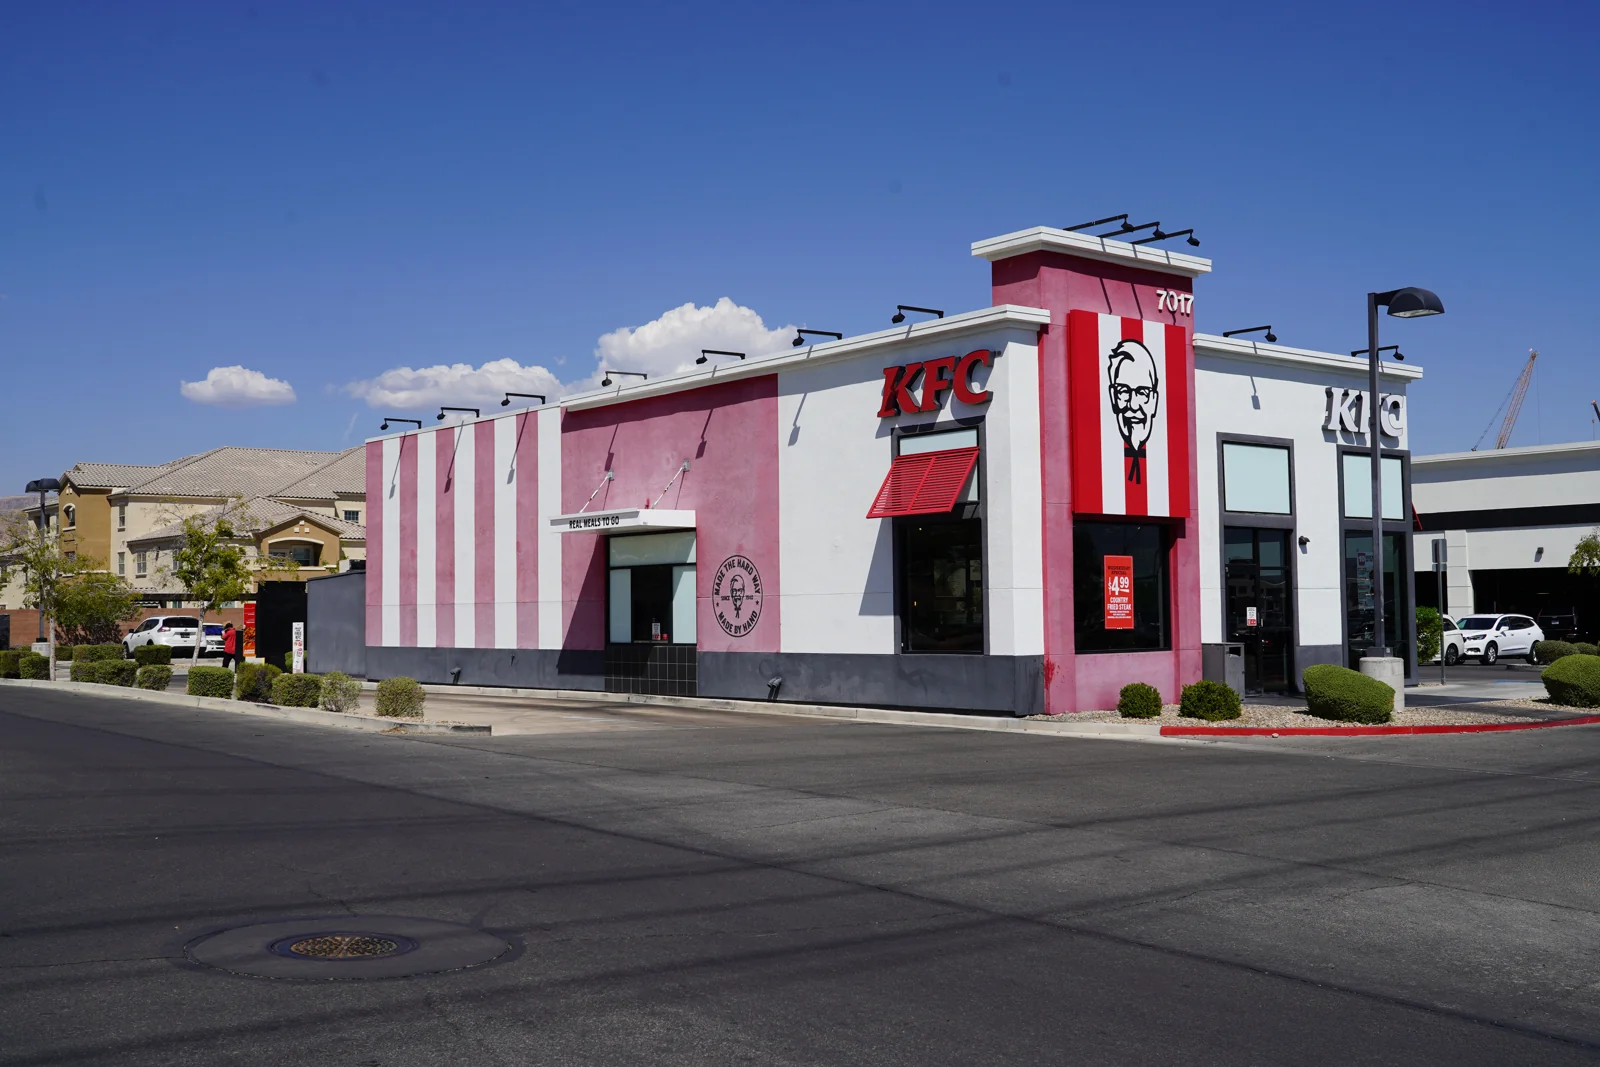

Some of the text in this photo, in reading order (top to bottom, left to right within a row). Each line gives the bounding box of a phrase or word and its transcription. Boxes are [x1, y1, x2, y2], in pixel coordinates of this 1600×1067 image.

[1156, 289, 1194, 314] 7017
[877, 349, 994, 418] KFC
[569, 516, 619, 529] REAL MEALS TO GO
[714, 559, 761, 596] MADE THE HARD WAY
[718, 610, 758, 634] MADE BY HAND
